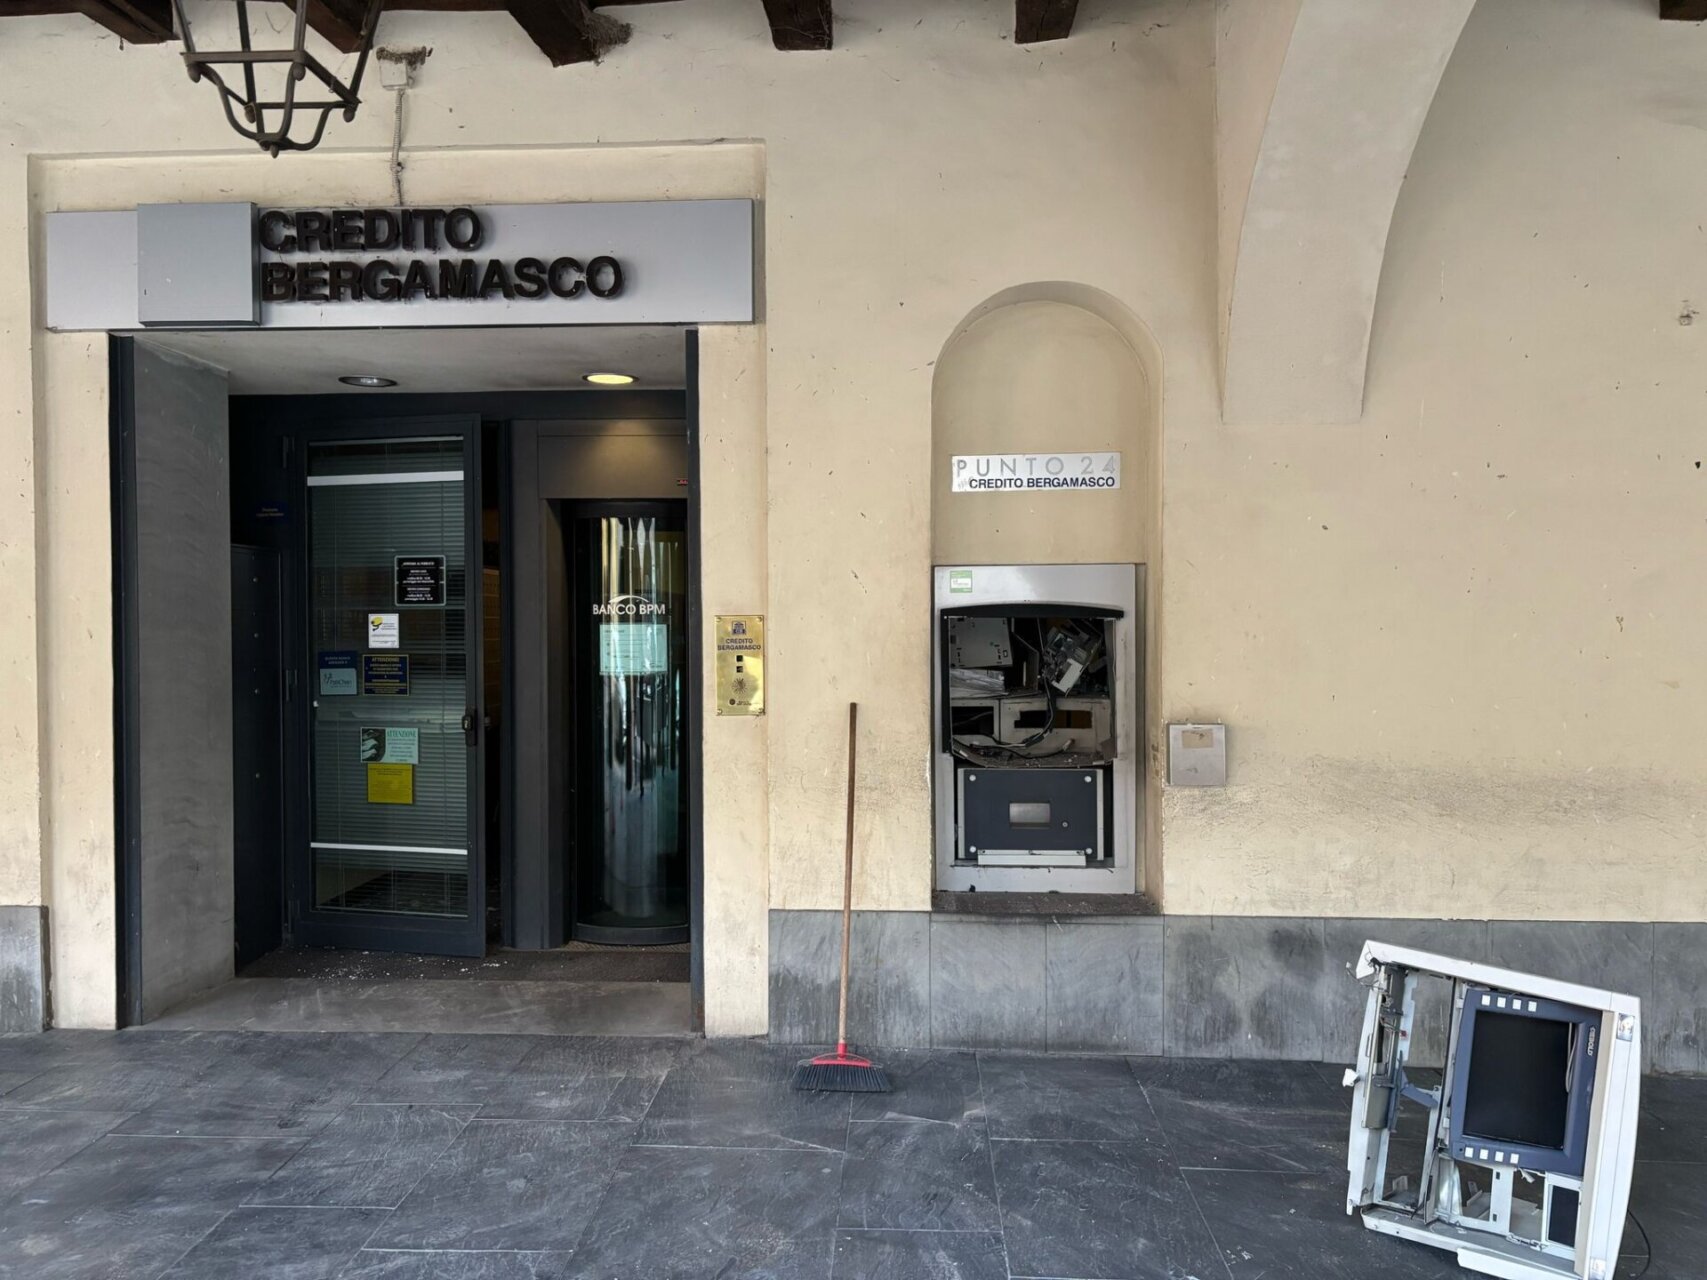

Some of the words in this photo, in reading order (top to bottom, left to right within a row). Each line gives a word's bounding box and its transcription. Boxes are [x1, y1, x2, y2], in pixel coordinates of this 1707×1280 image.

[259, 207, 483, 251] CREDITO
[261, 256, 624, 302] BERGAMASCO
[956, 456, 1065, 478] PUNTO
[1080, 455, 1116, 476] 24
[969, 478, 1024, 489] CREDITO
[1026, 476, 1116, 488] BERGAMASCO
[592, 603, 637, 615] BANCO
[638, 603, 666, 615] BPM
